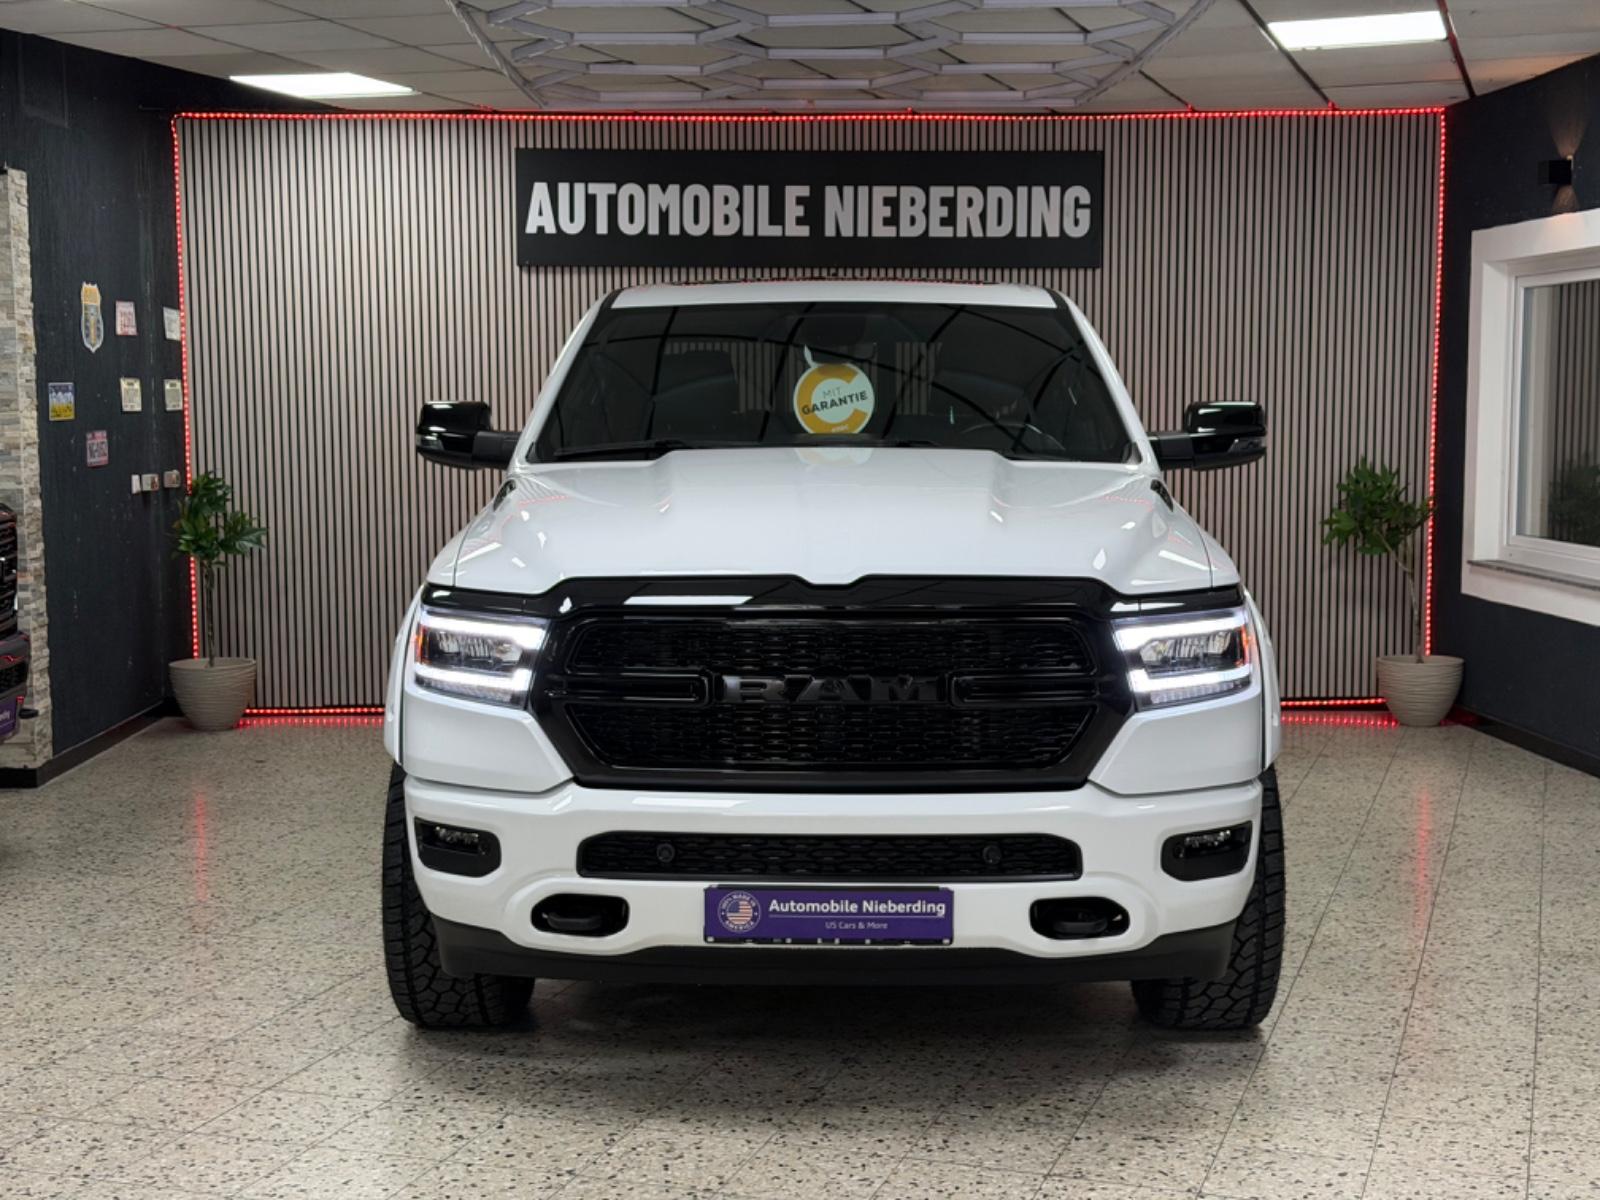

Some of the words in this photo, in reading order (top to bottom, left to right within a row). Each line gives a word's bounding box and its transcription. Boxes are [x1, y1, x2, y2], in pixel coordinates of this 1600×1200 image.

[525, 182, 811, 237] AUTOMOBILE
[823, 184, 1092, 239] NIEBERDING
[801, 390, 868, 415] GARANTIE
[822, 386, 842, 398] MIT
[721, 673, 939, 704] RAM
[768, 899, 859, 914] Automobile
[862, 899, 946, 917] Nieberding
[825, 921, 837, 929] US
[838, 921, 857, 930] Cars
[858, 921, 866, 930] &
[866, 921, 888, 930] More
